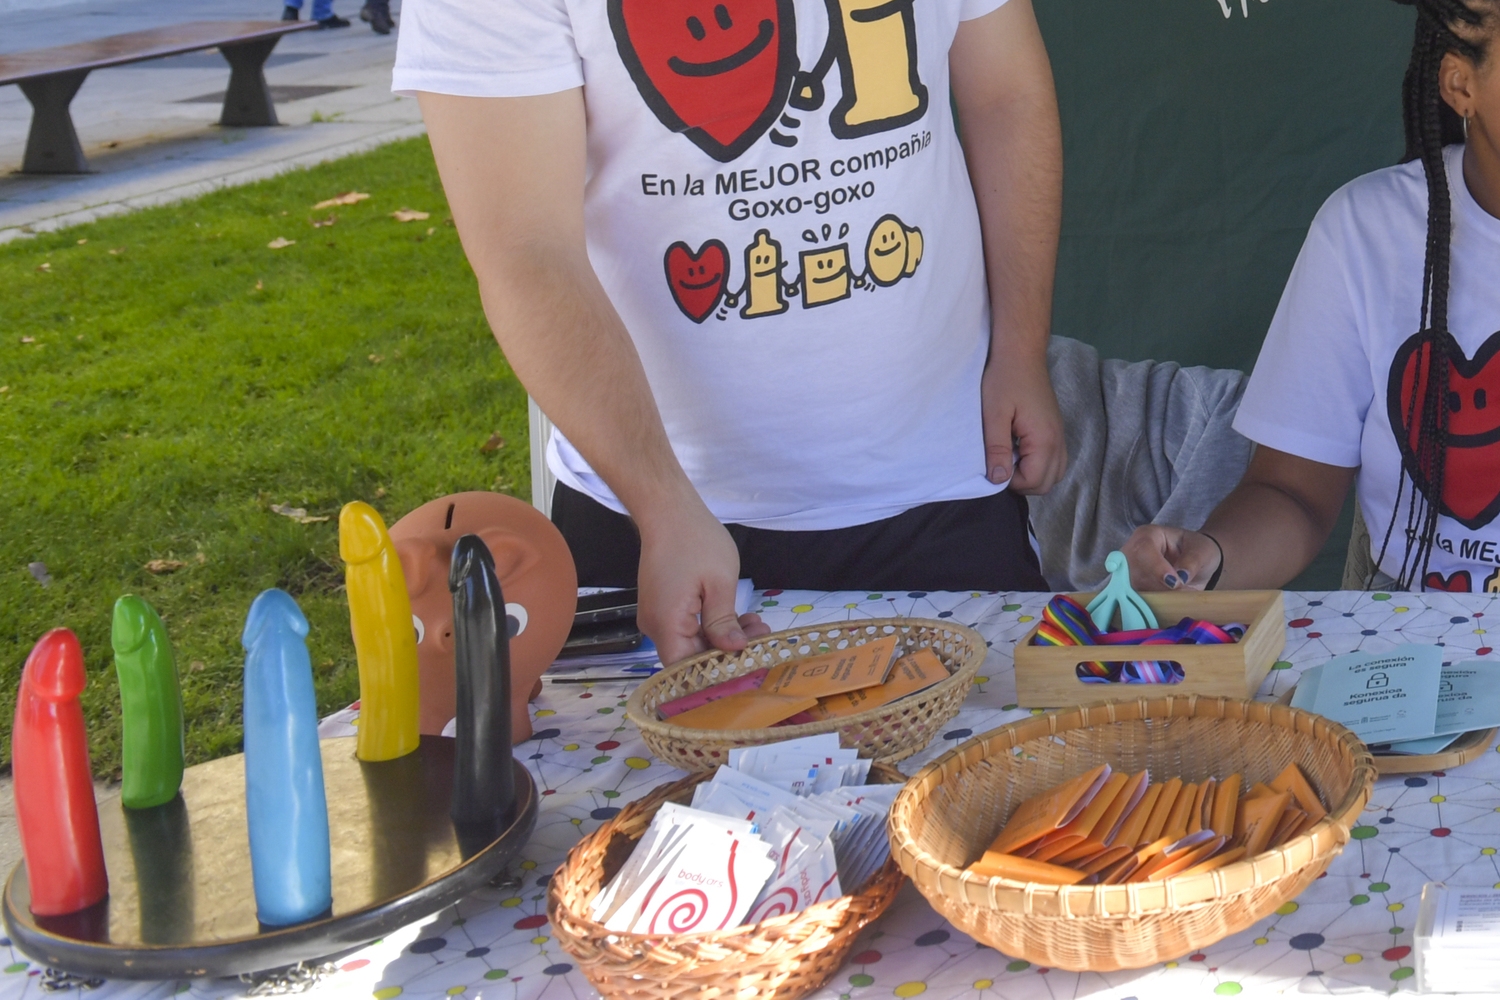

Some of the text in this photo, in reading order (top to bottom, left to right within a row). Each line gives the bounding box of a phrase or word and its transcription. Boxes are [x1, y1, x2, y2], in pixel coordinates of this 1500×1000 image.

[641, 174, 676, 196] En
[683, 173, 705, 196] la
[715, 159, 822, 195] MEJOR
[728, 180, 875, 221] Goxo-goxo
[1436, 532, 1454, 555] la
[1364, 656, 1415, 668] conexión
[1369, 662, 1407, 672] segura
[1350, 688, 1403, 699] Konexioa
[1343, 695, 1389, 707] segurua
